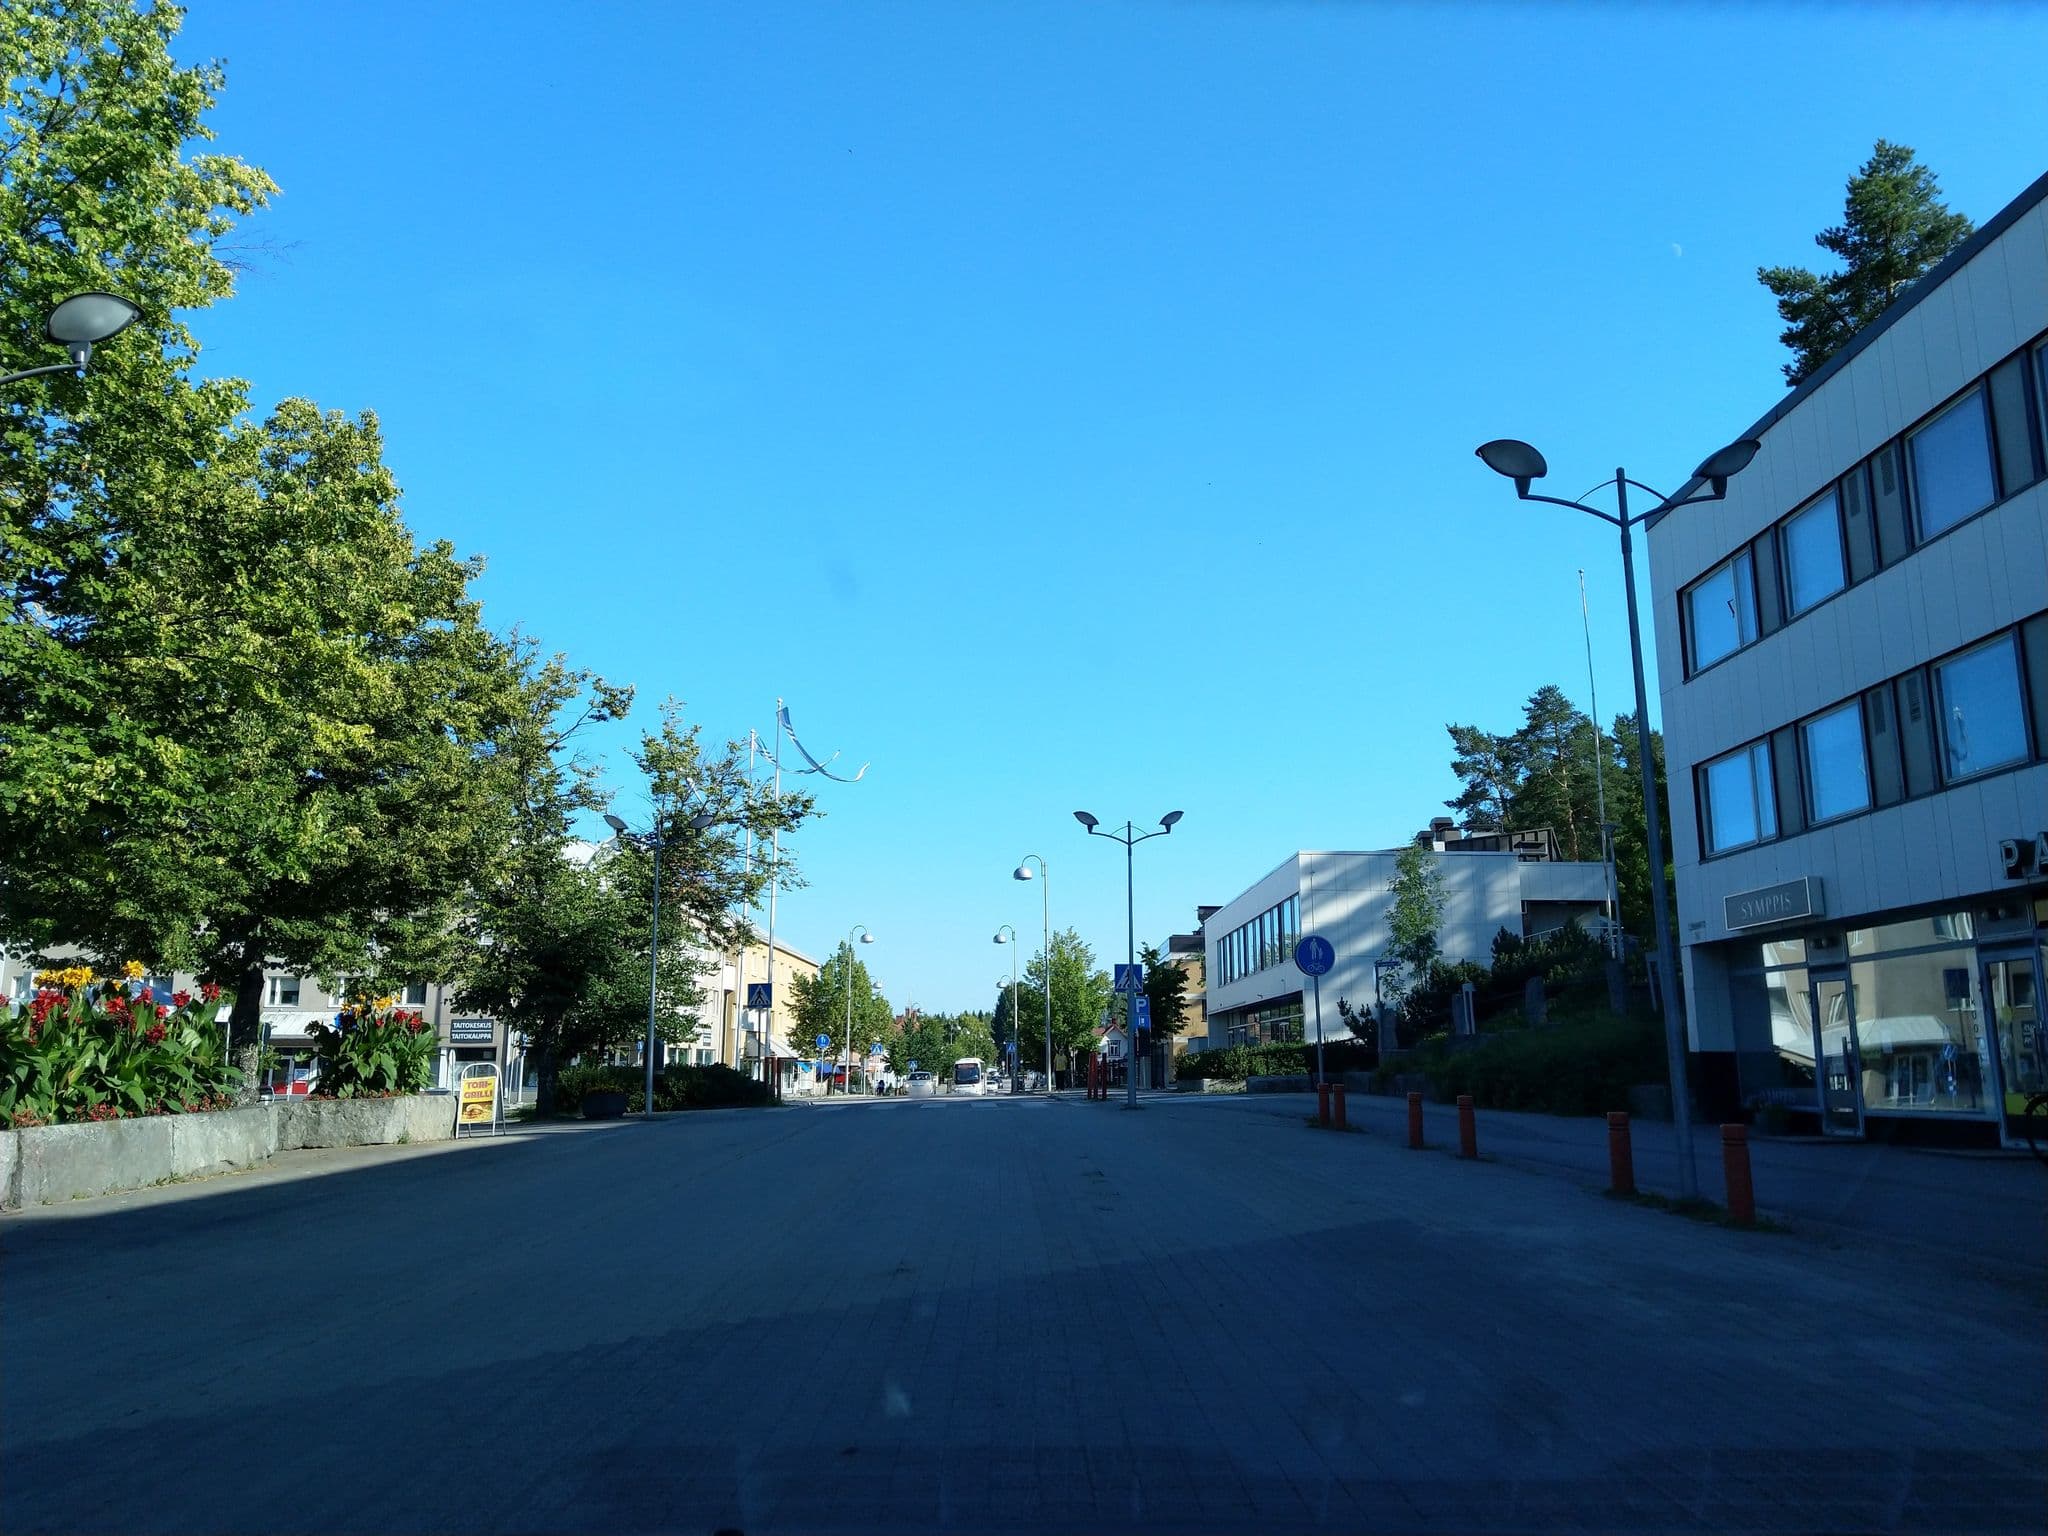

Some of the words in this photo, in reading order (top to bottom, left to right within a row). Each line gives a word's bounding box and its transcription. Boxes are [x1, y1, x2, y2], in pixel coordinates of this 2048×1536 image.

[1740, 894, 1791, 920] SYMPPIS
[1135, 998, 1147, 1013] P
[451, 1032, 492, 1040] TAITOKAUPPA
